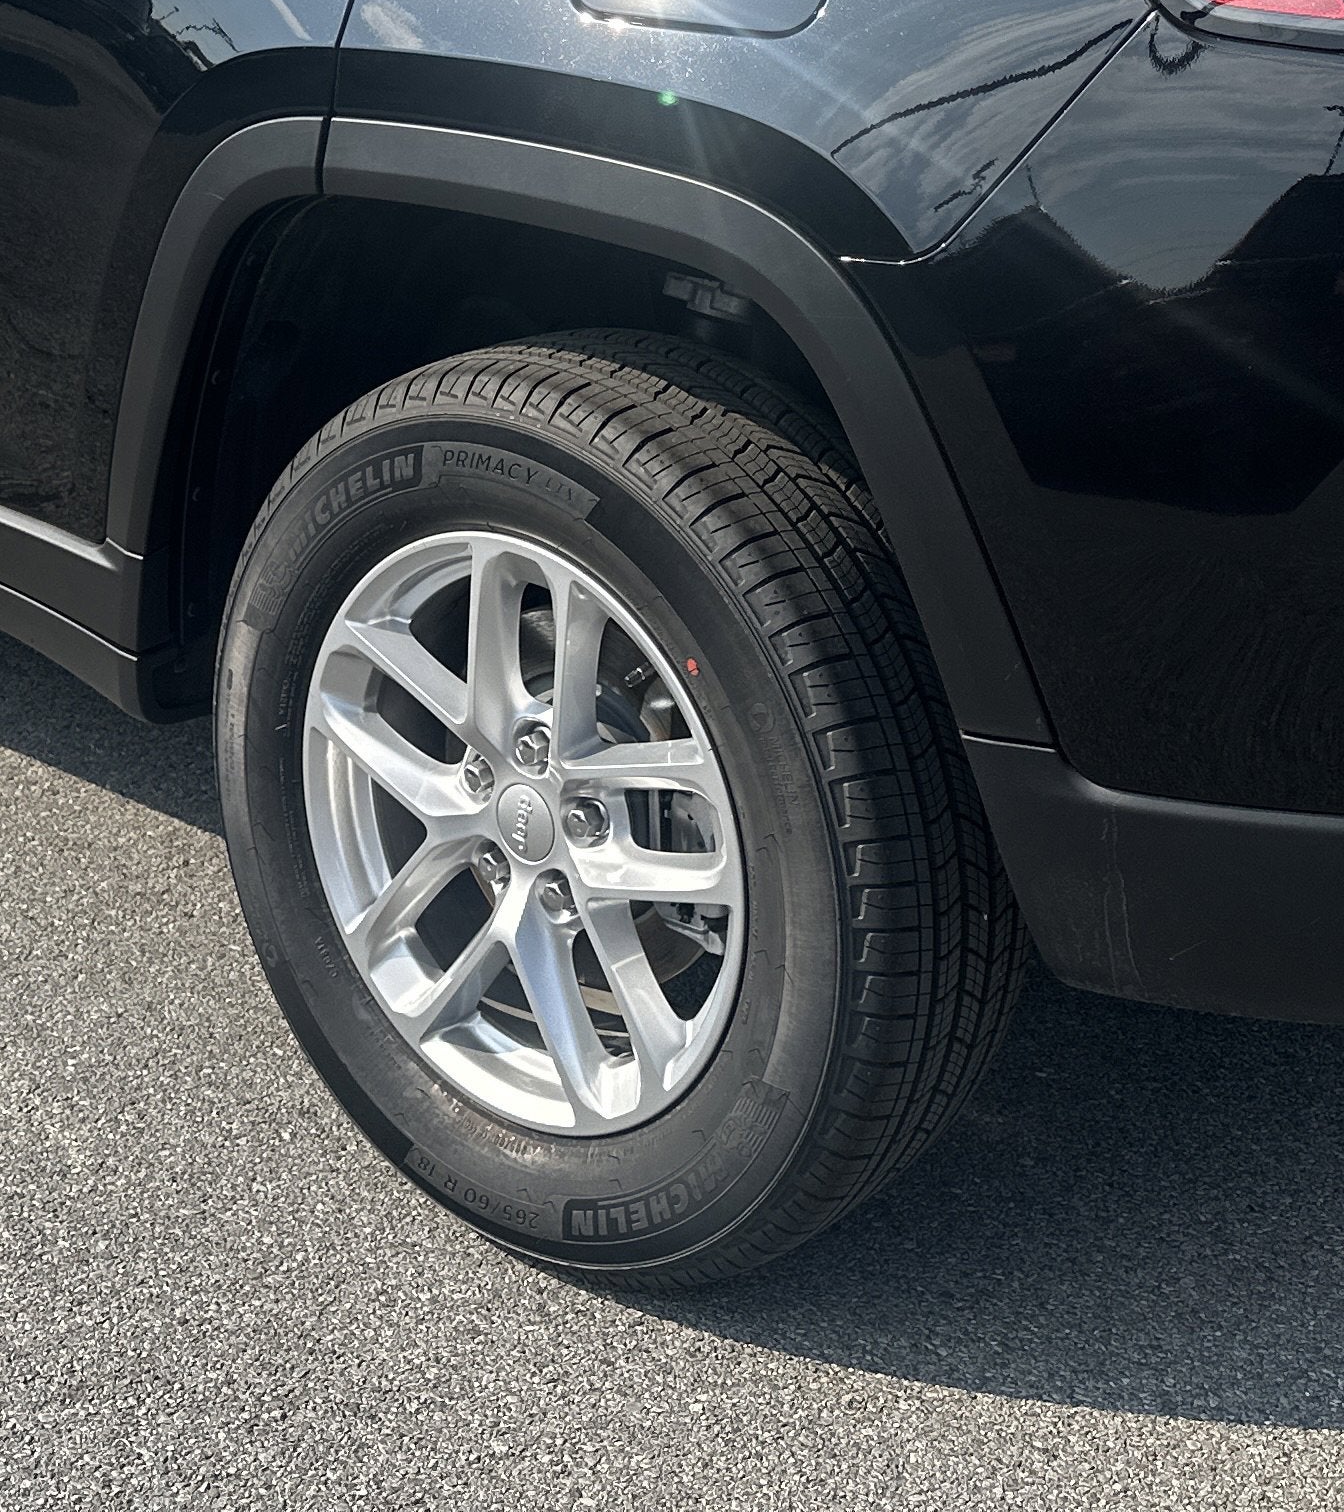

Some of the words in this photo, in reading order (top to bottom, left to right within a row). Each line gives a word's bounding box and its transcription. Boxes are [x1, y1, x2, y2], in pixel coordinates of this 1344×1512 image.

[287, 453, 415, 562] MICHELIN
[442, 449, 539, 486] PRIMACY
[417, 1156, 436, 1177] 18
[443, 1174, 458, 1193] R
[463, 1187, 540, 1229] 265/60
[570, 1152, 732, 1236] MICHELIN
